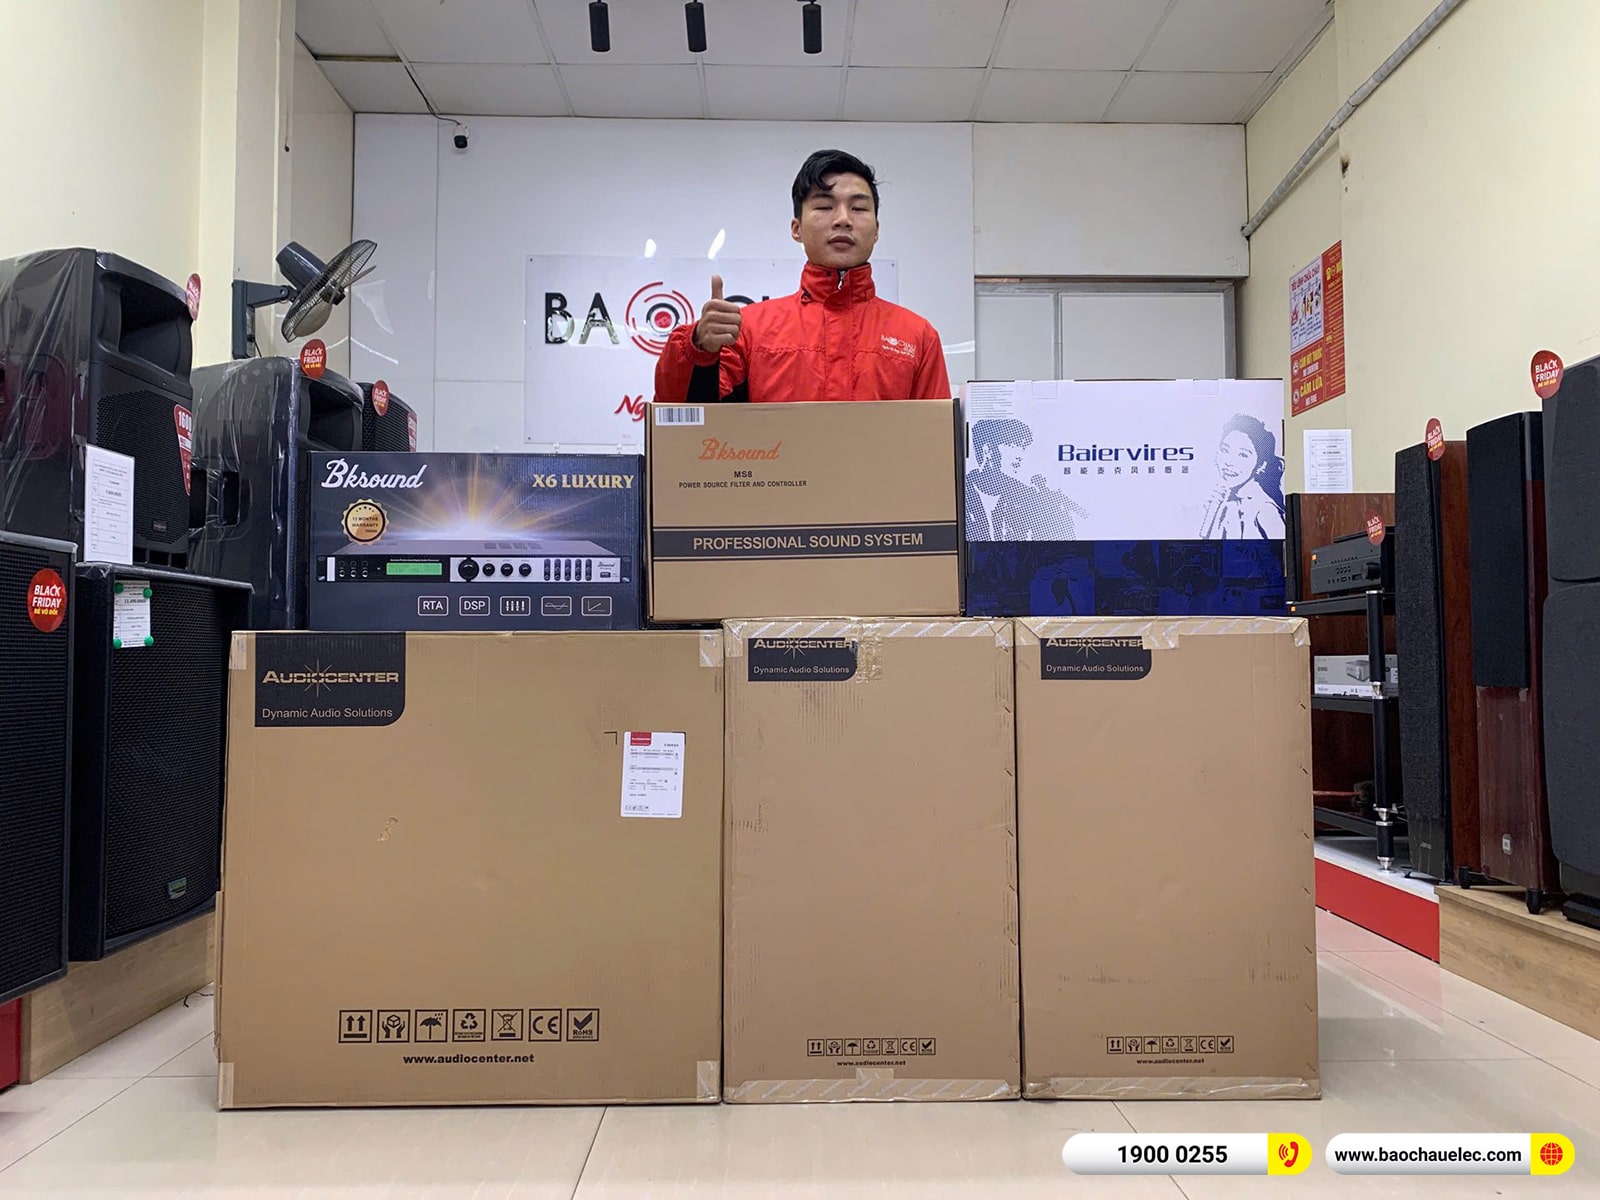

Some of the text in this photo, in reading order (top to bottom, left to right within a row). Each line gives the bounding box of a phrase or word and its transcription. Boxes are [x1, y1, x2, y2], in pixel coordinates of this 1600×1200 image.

[304, 347, 323, 356] BLACK
[303, 355, 324, 364] FRIDAY
[1535, 359, 1558, 373] BLACK
[1535, 368, 1560, 383] FRIDAY
[1427, 426, 1441, 440] BLACK
[698, 437, 783, 461] Bksound
[1058, 444, 1194, 461] Baiervires
[321, 458, 428, 489] Bksound
[733, 470, 753, 479] MS8
[532, 473, 635, 489] X6 LUXURY
[678, 481, 701, 489] POWER
[703, 481, 728, 489] SOURCE
[1366, 516, 1380, 528] BLACK
[693, 532, 923, 550] PROFESSIONAL SOUND SYSTEM
[34, 584, 61, 597] BLACK
[32, 596, 62, 609] FRIDAY
[423, 600, 443, 610] RTA
[464, 600, 485, 610] DSP
[753, 666, 788, 675] Dynamic
[1046, 664, 1144, 673] Dynamic Audio Solutions
[262, 670, 399, 684] AUDIOCENTER
[262, 708, 393, 720] Dynamic Audio Solutions
[403, 1054, 534, 1064] www.audiocenter.net
